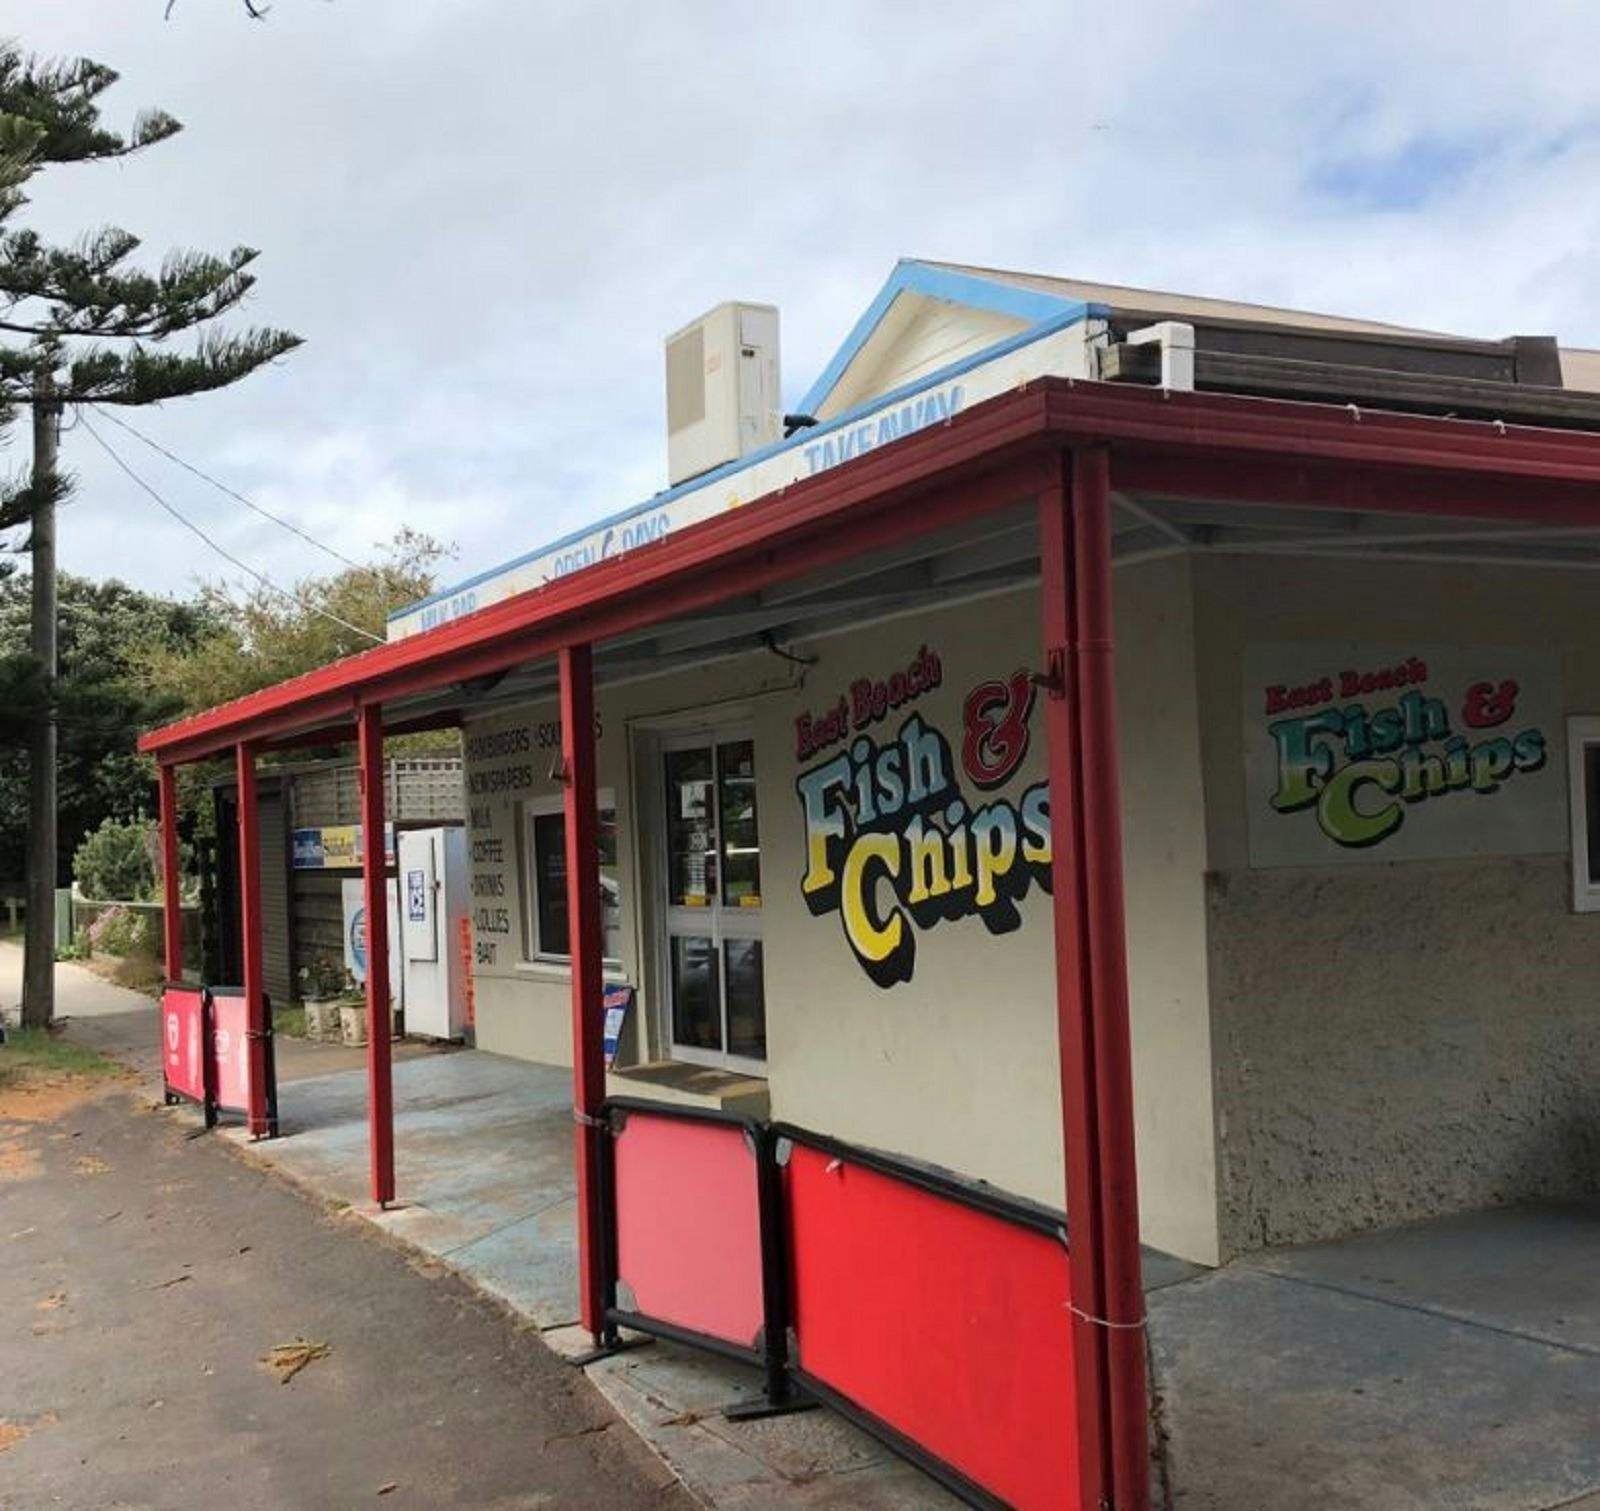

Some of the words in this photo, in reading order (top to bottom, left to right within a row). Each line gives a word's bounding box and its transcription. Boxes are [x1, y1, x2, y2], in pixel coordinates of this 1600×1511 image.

[804, 384, 967, 473] TAKEAWAY
[795, 695, 849, 762] East
[850, 644, 943, 730] Beach
[1265, 678, 1333, 715] East
[1339, 657, 1428, 698] Beach
[467, 765, 533, 795] NEWSPAPERS
[796, 711, 958, 914] Fish
[962, 668, 1037, 791] &
[1268, 689, 1450, 814] Fish
[1462, 679, 1519, 729] &
[1317, 728, 1547, 847] Chips
[473, 839, 503, 863] COFFEE
[474, 873, 504, 897] DRINKS
[841, 779, 1053, 986] Chips
